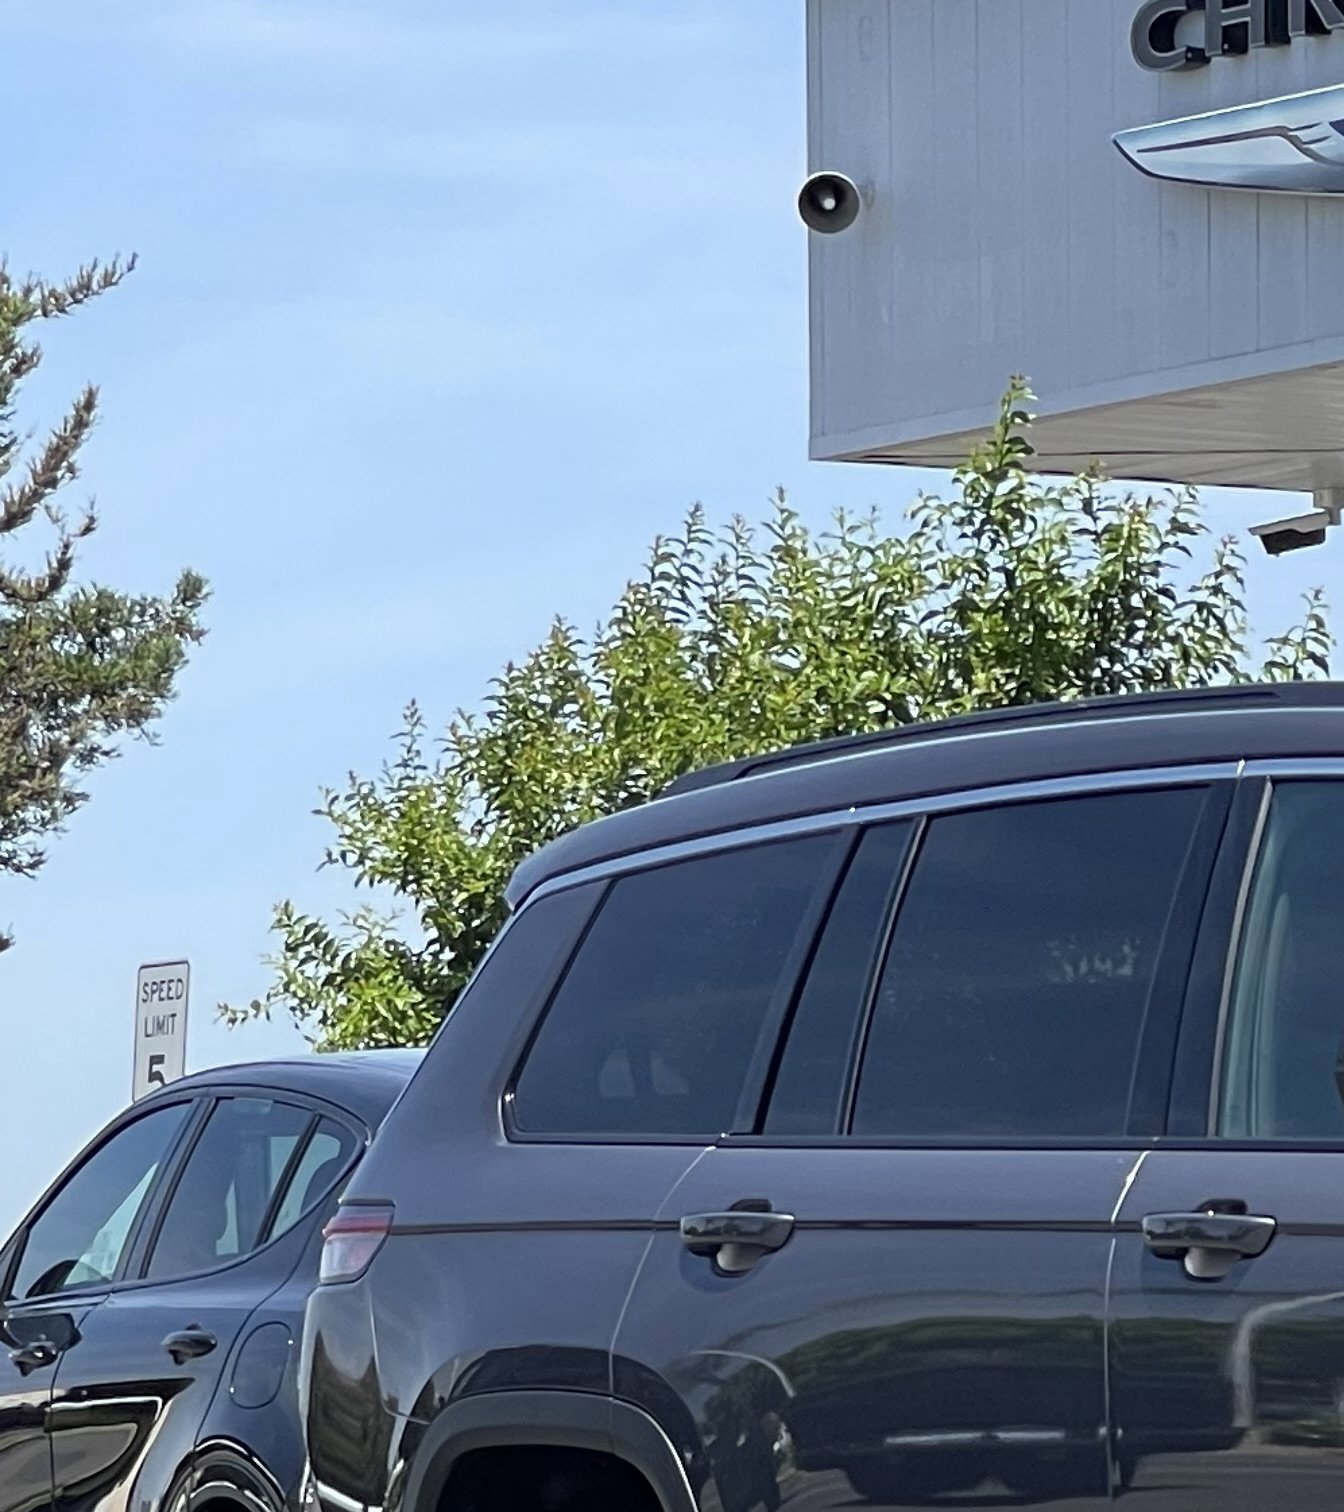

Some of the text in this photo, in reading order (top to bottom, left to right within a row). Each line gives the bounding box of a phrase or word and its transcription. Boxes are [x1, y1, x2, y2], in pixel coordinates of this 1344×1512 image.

[142, 978, 184, 1003] SPEED
[144, 1013, 177, 1037] LIMIT
[148, 1054, 166, 1086] 5
